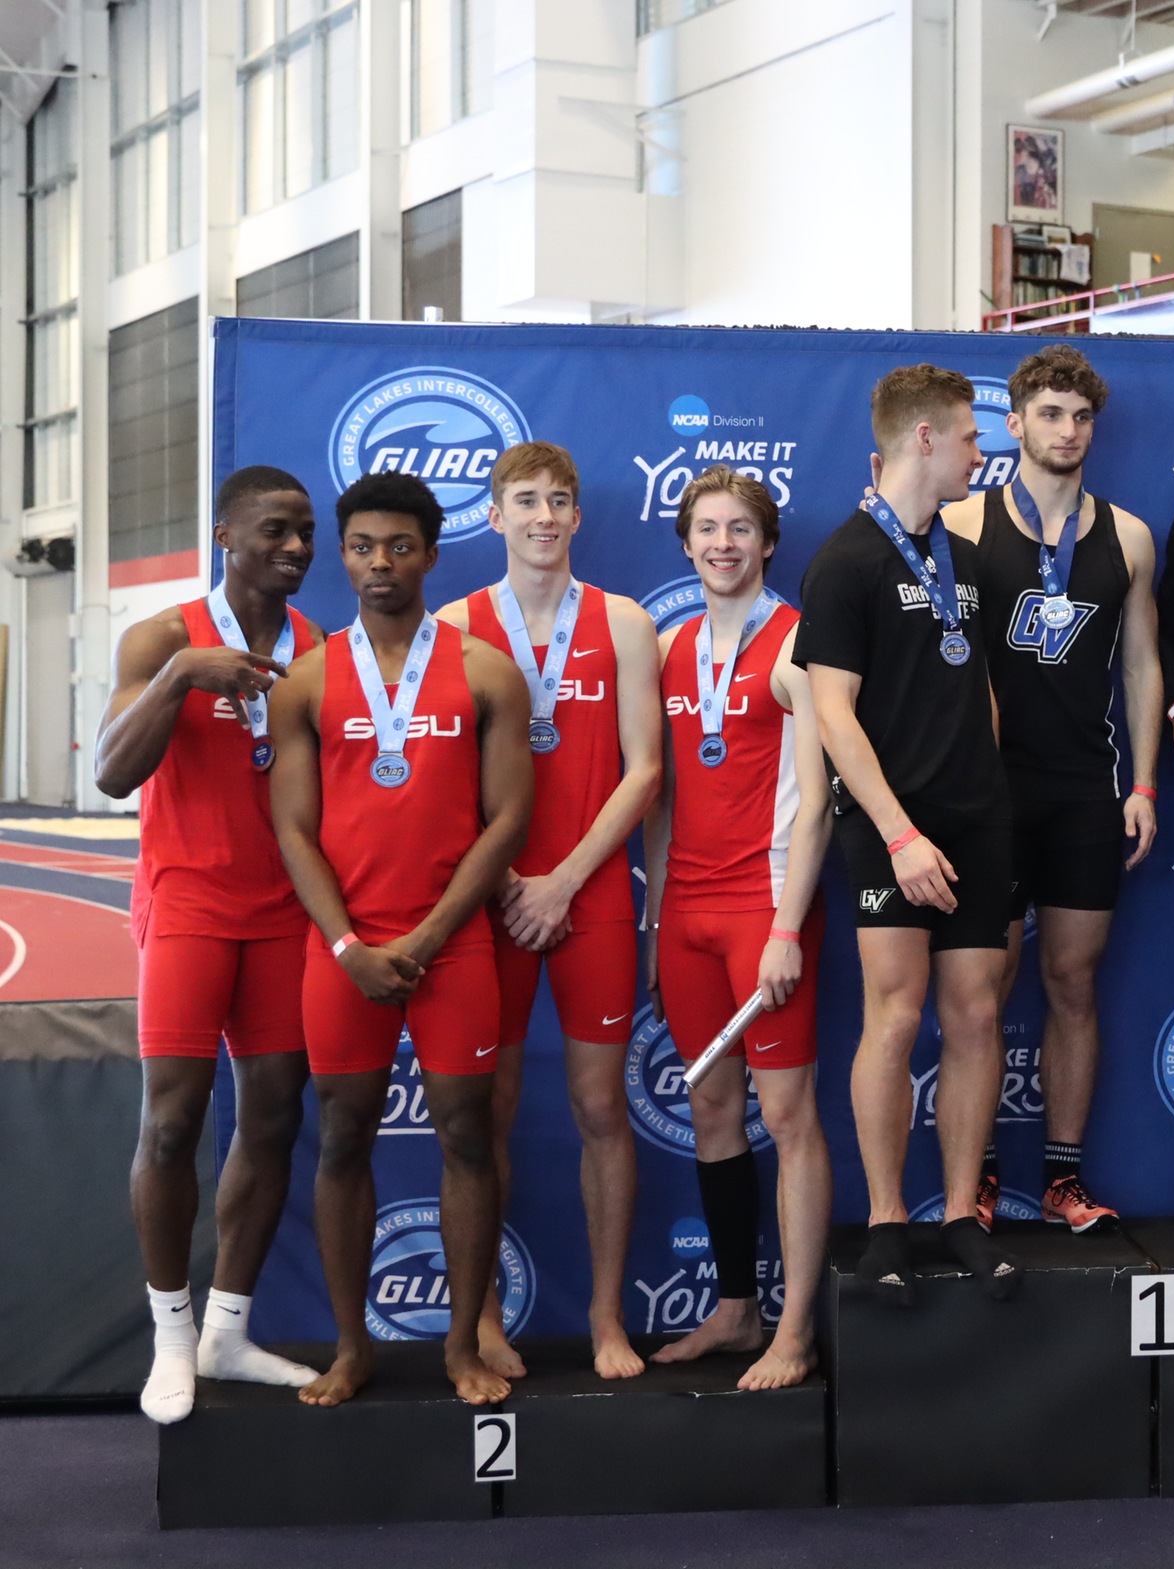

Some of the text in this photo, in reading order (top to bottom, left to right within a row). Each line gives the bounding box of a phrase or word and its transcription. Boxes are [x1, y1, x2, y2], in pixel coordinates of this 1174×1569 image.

[343, 379, 521, 466] GREAT LAKES INTERCOLLEGIA
[672, 414, 764, 427] NCAA Division II
[695, 440, 797, 462] MAKE IT
[369, 447, 499, 479] GLIAC
[556, 679, 605, 701] SU
[666, 695, 748, 716] SVU
[344, 715, 461, 739] SSU
[529, 735, 554, 743] GLIAC
[377, 767, 404, 777] GLIAC
[860, 888, 896, 913] GV
[628, 1033, 649, 1086] GREAT
[373, 1212, 413, 1243] AKES
[673, 1236, 709, 1248] NCAA
[476, 1417, 514, 1479] 2
